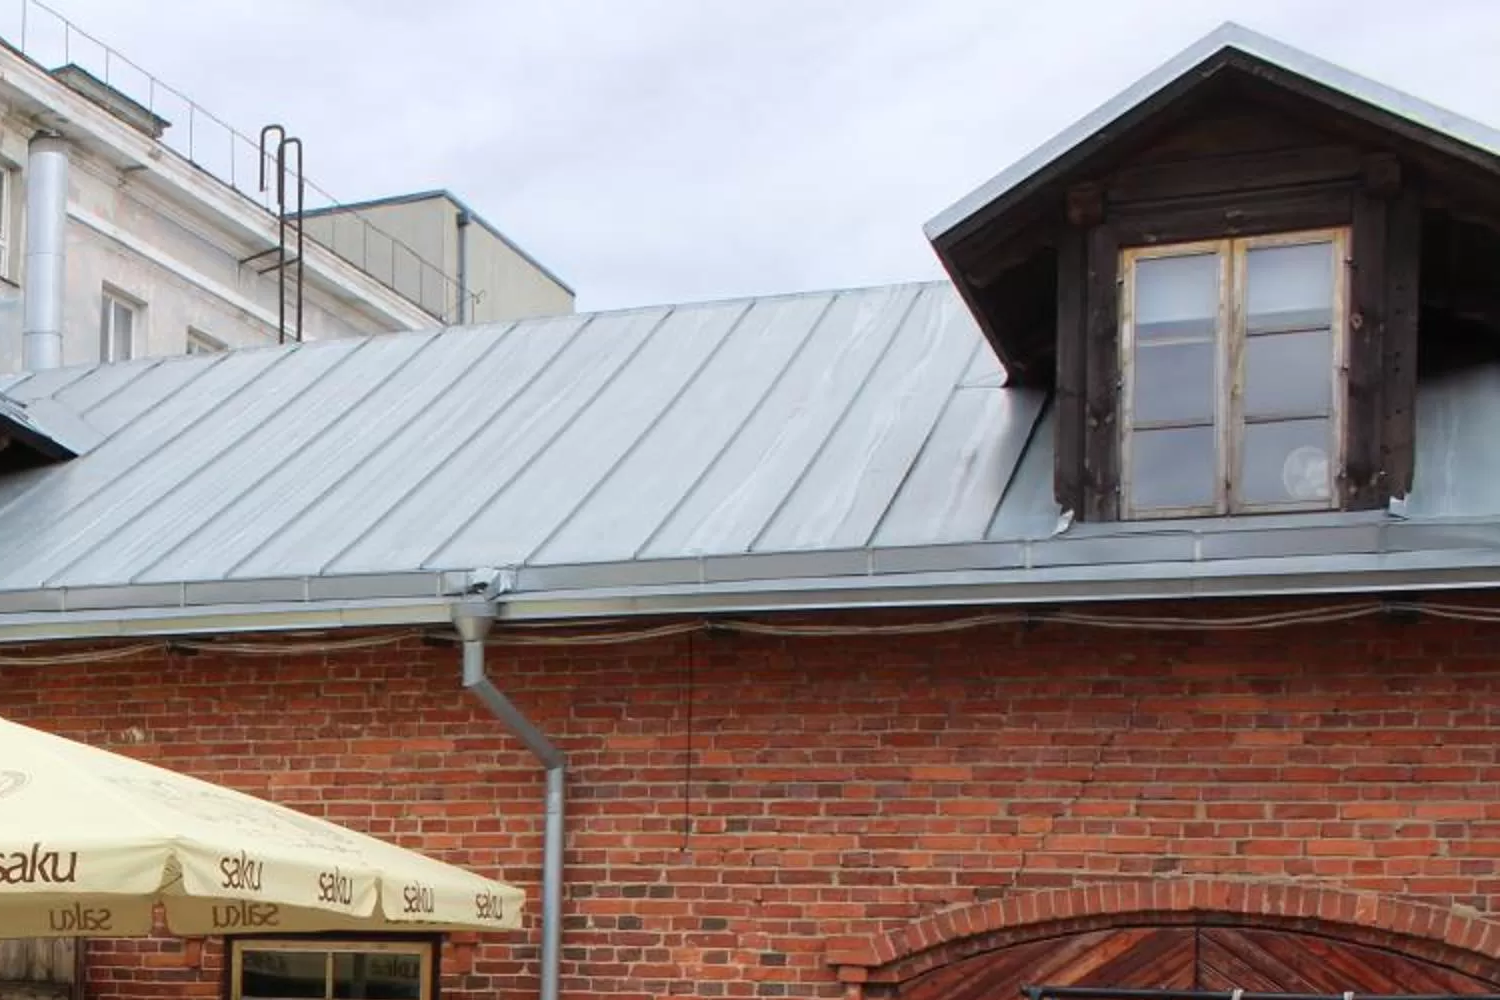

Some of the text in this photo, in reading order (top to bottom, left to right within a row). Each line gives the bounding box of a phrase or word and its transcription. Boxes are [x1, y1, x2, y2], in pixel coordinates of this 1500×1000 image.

[219, 849, 265, 892] saku
[318, 865, 354, 906] saku
[403, 880, 435, 914] saku
[475, 887, 503, 920] saku
